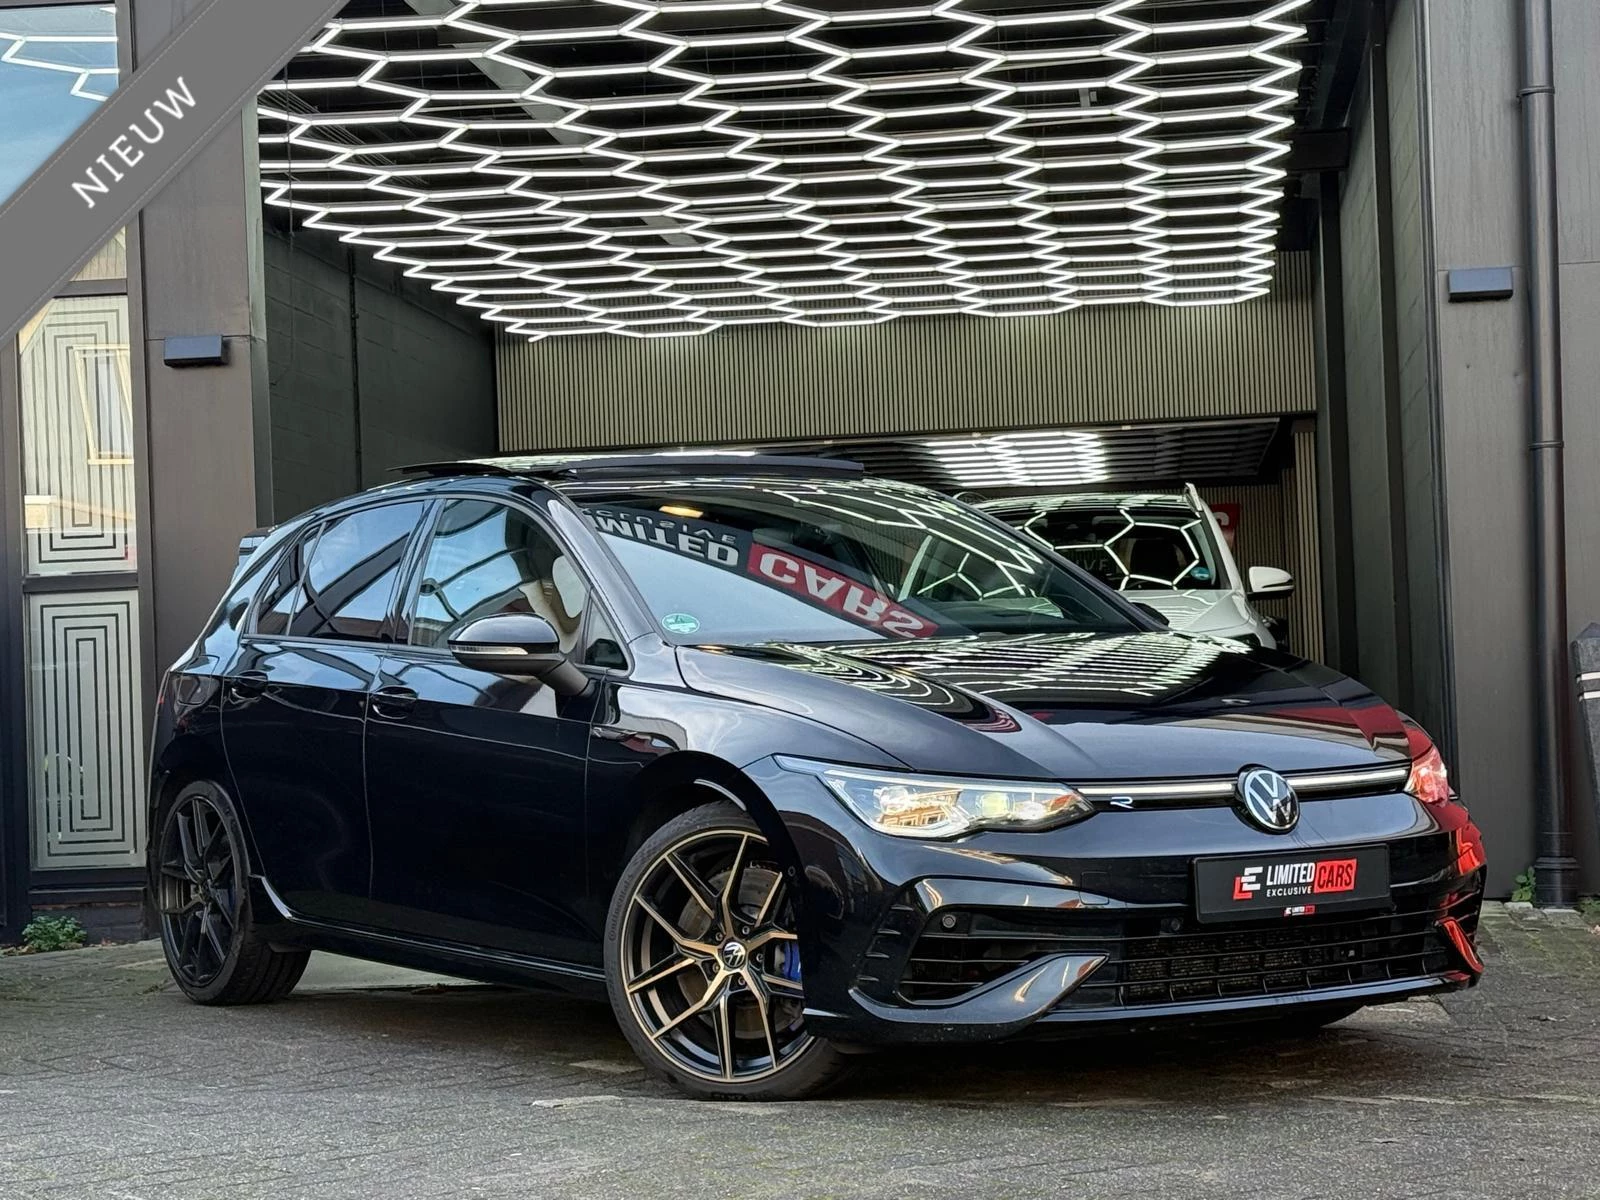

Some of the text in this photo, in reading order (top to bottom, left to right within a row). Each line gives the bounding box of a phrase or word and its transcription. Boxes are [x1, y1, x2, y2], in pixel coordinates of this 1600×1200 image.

[1266, 862, 1316, 887] LIMITED
[1317, 863, 1354, 889] CARS
[1266, 886, 1313, 898] EXCLUSIVE
